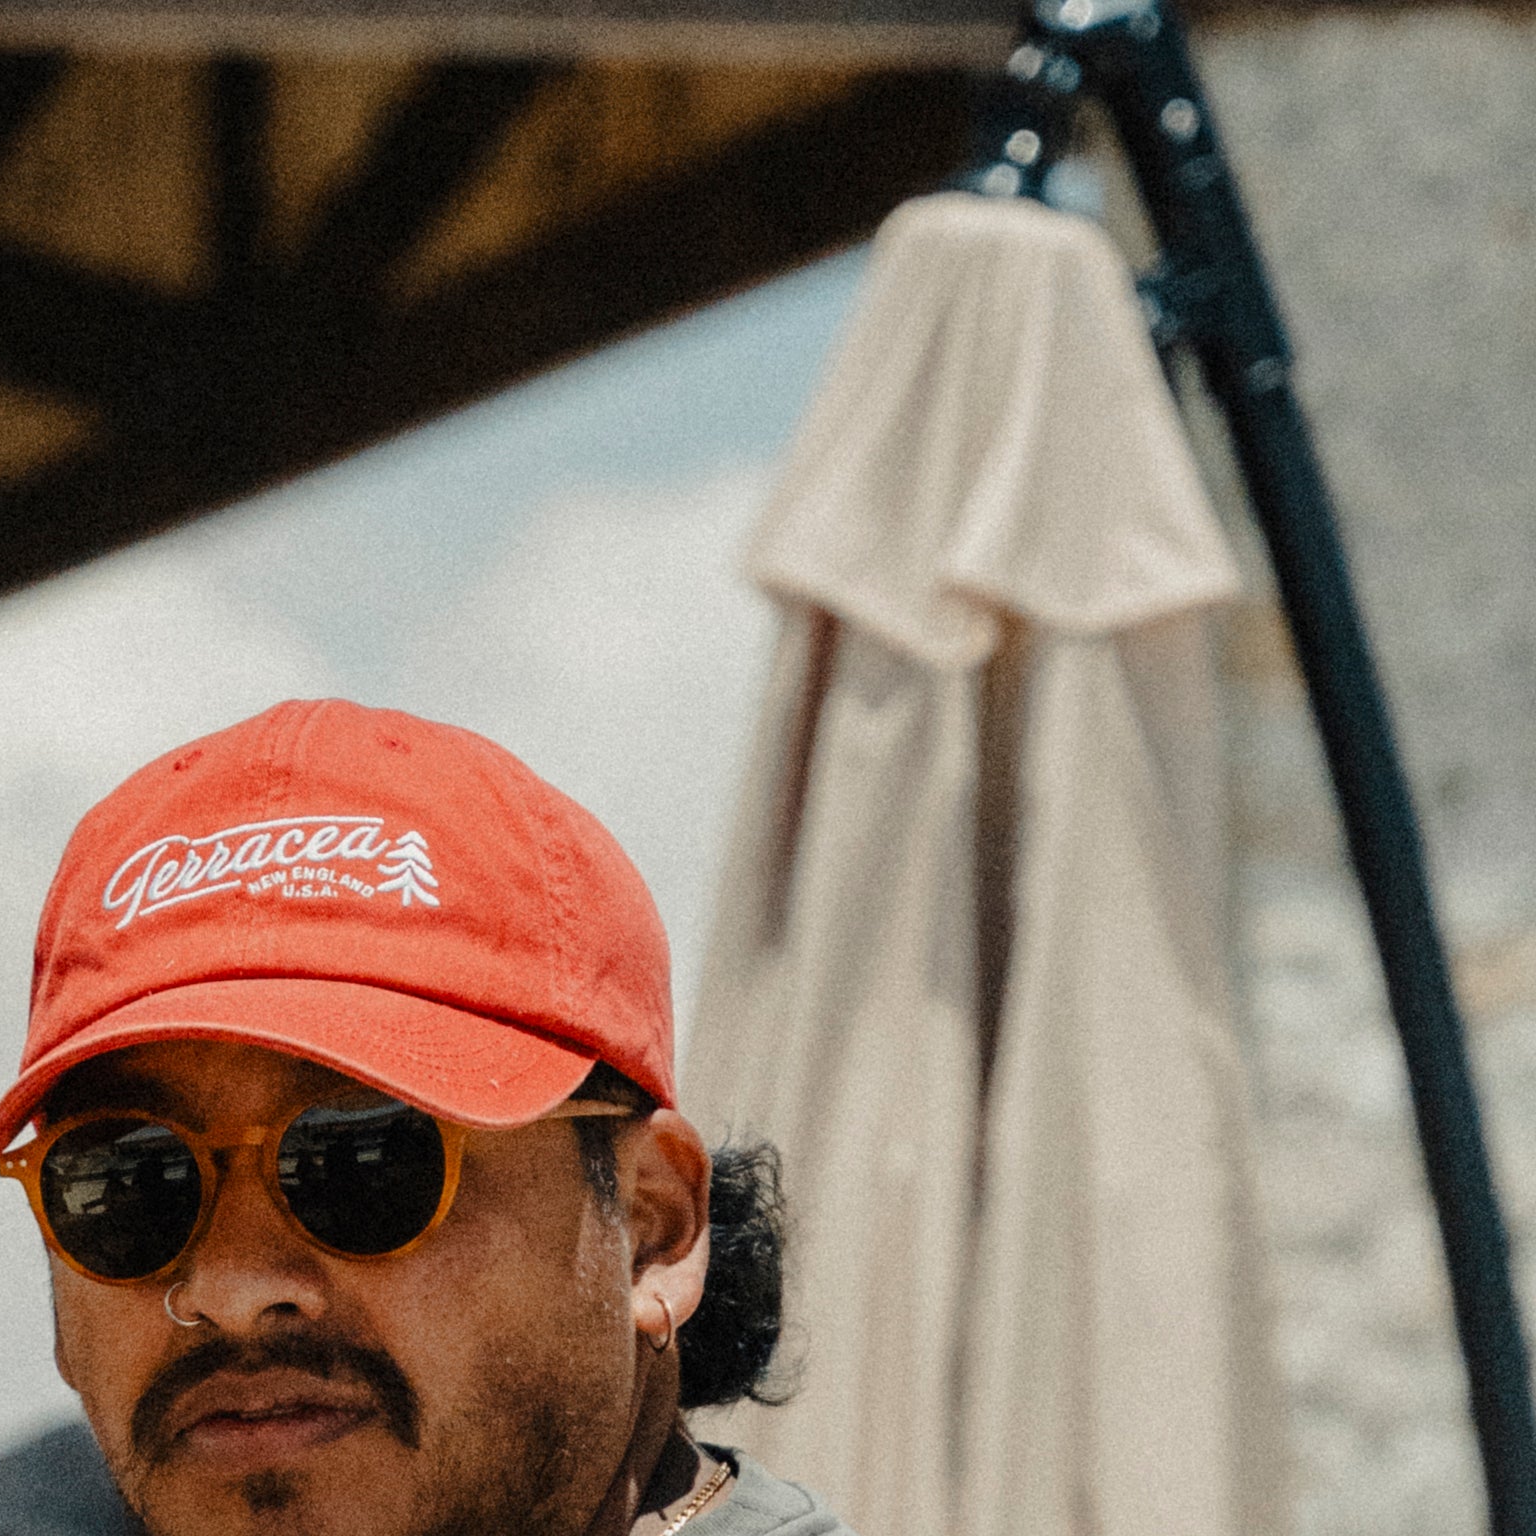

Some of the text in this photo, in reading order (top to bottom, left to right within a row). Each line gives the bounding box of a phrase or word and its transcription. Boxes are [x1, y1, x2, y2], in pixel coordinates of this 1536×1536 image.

[102, 815, 392, 930] Terracea
[247, 866, 375, 898] NEW ENGLAND
[282, 883, 338, 898] U.S.A.
